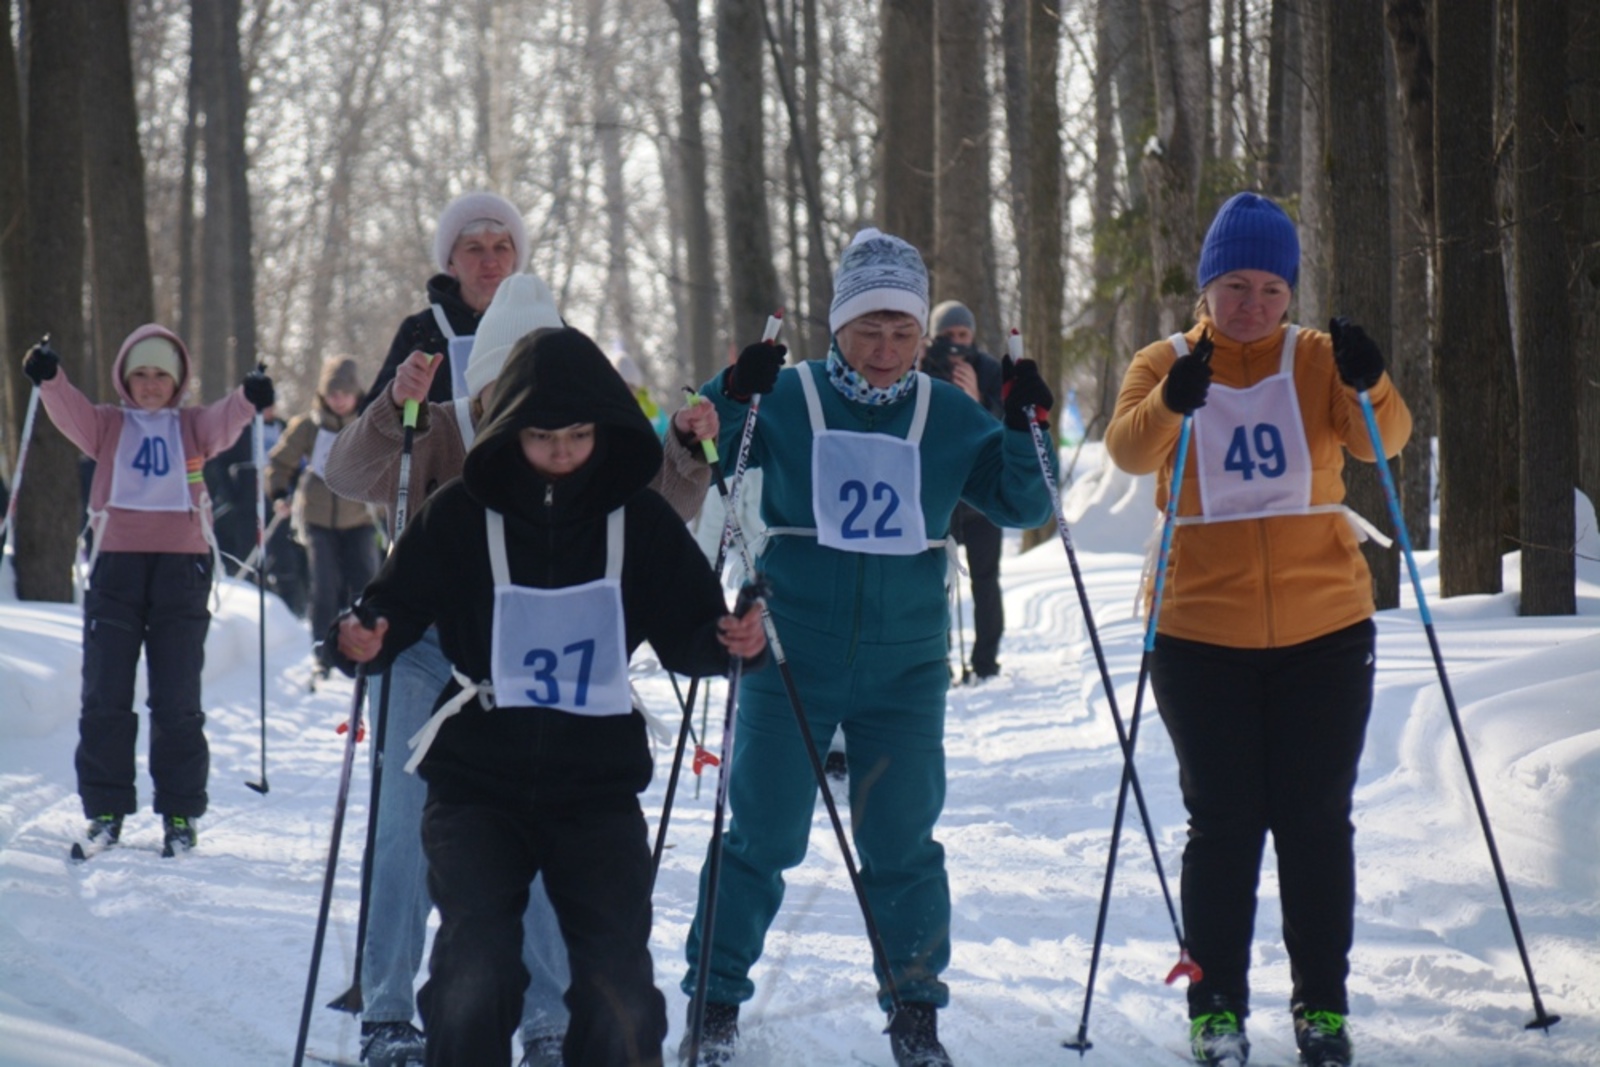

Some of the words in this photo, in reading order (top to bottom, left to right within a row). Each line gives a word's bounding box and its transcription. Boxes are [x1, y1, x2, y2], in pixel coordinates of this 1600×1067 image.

[131, 435, 170, 478] 40
[1223, 422, 1287, 481] 49
[839, 479, 903, 540] 22
[524, 638, 595, 706] 37
